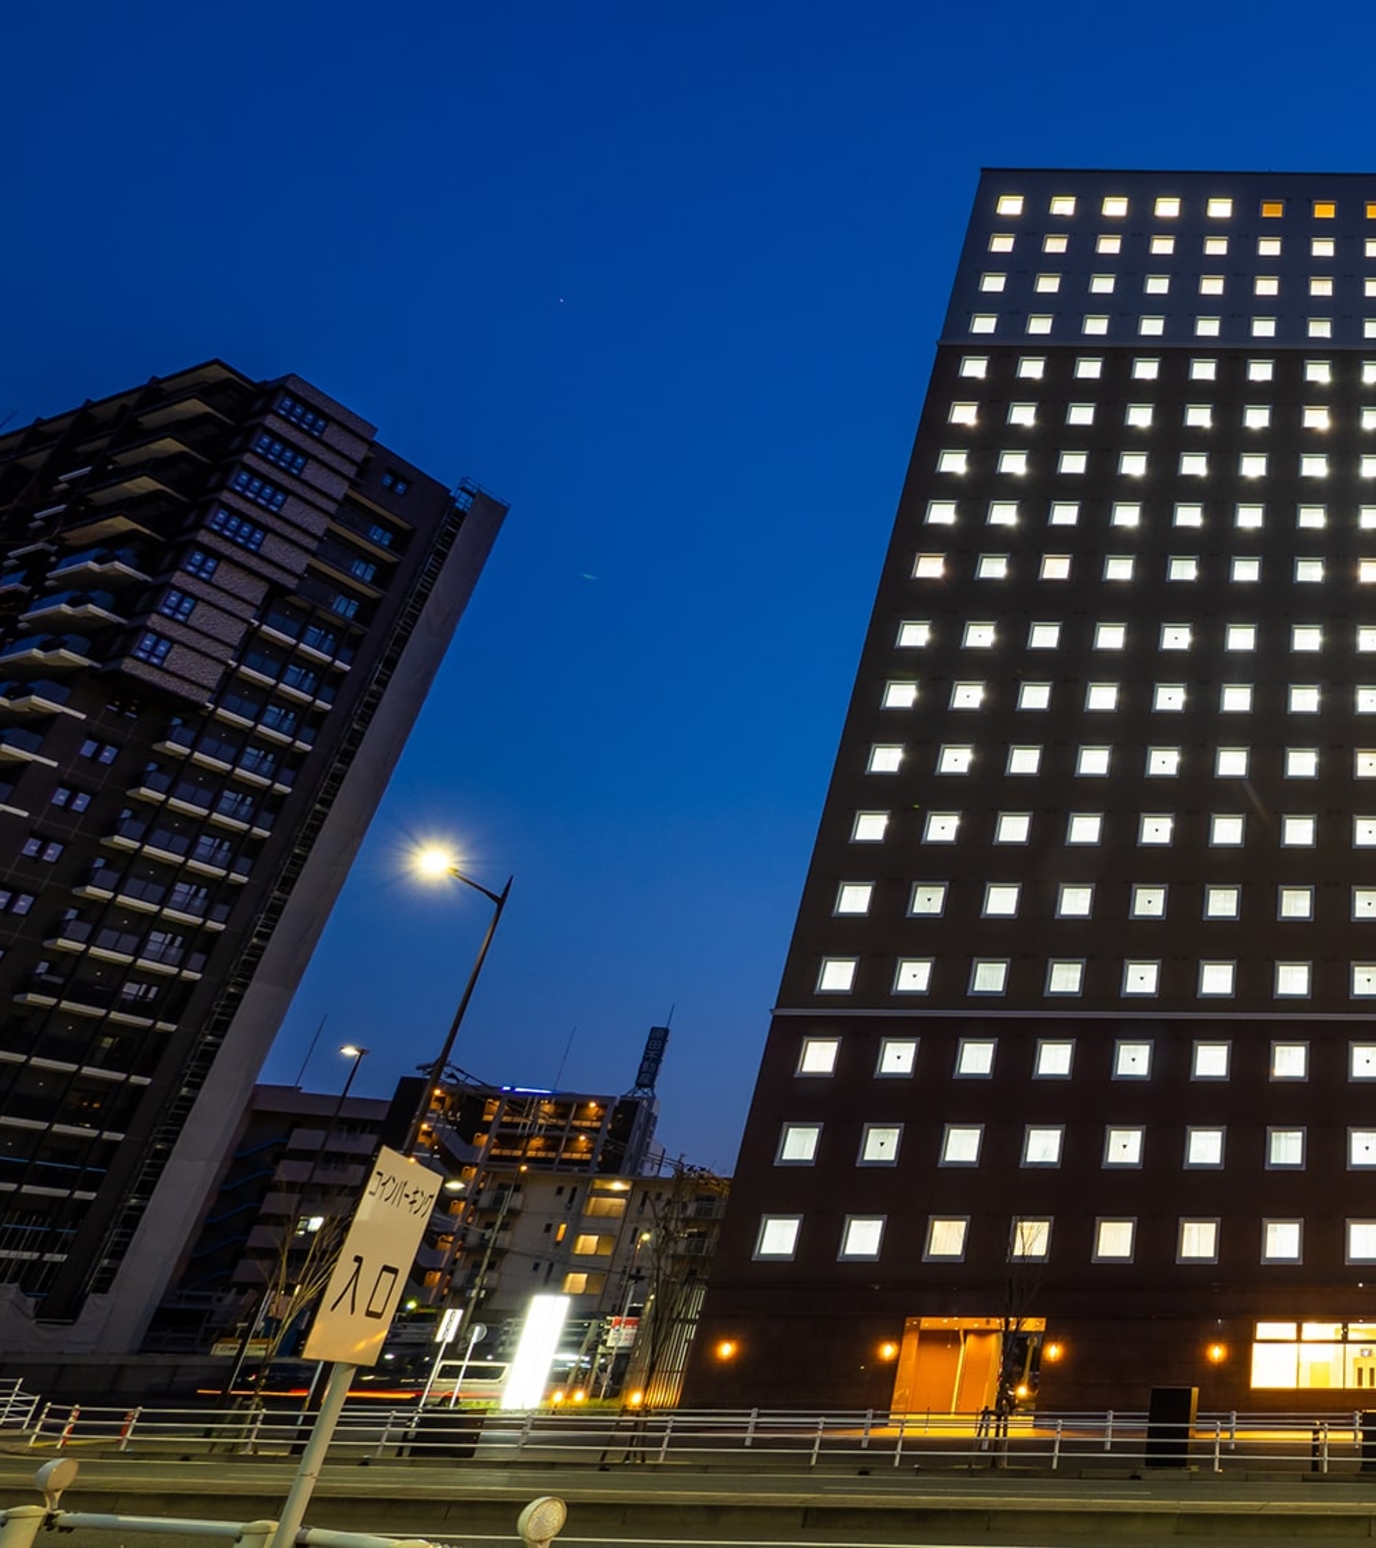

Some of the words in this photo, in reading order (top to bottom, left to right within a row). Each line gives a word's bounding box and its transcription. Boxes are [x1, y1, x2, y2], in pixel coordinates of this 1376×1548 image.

[369, 1171, 434, 1218] コインパーキング
[330, 1255, 399, 1319] 入口
